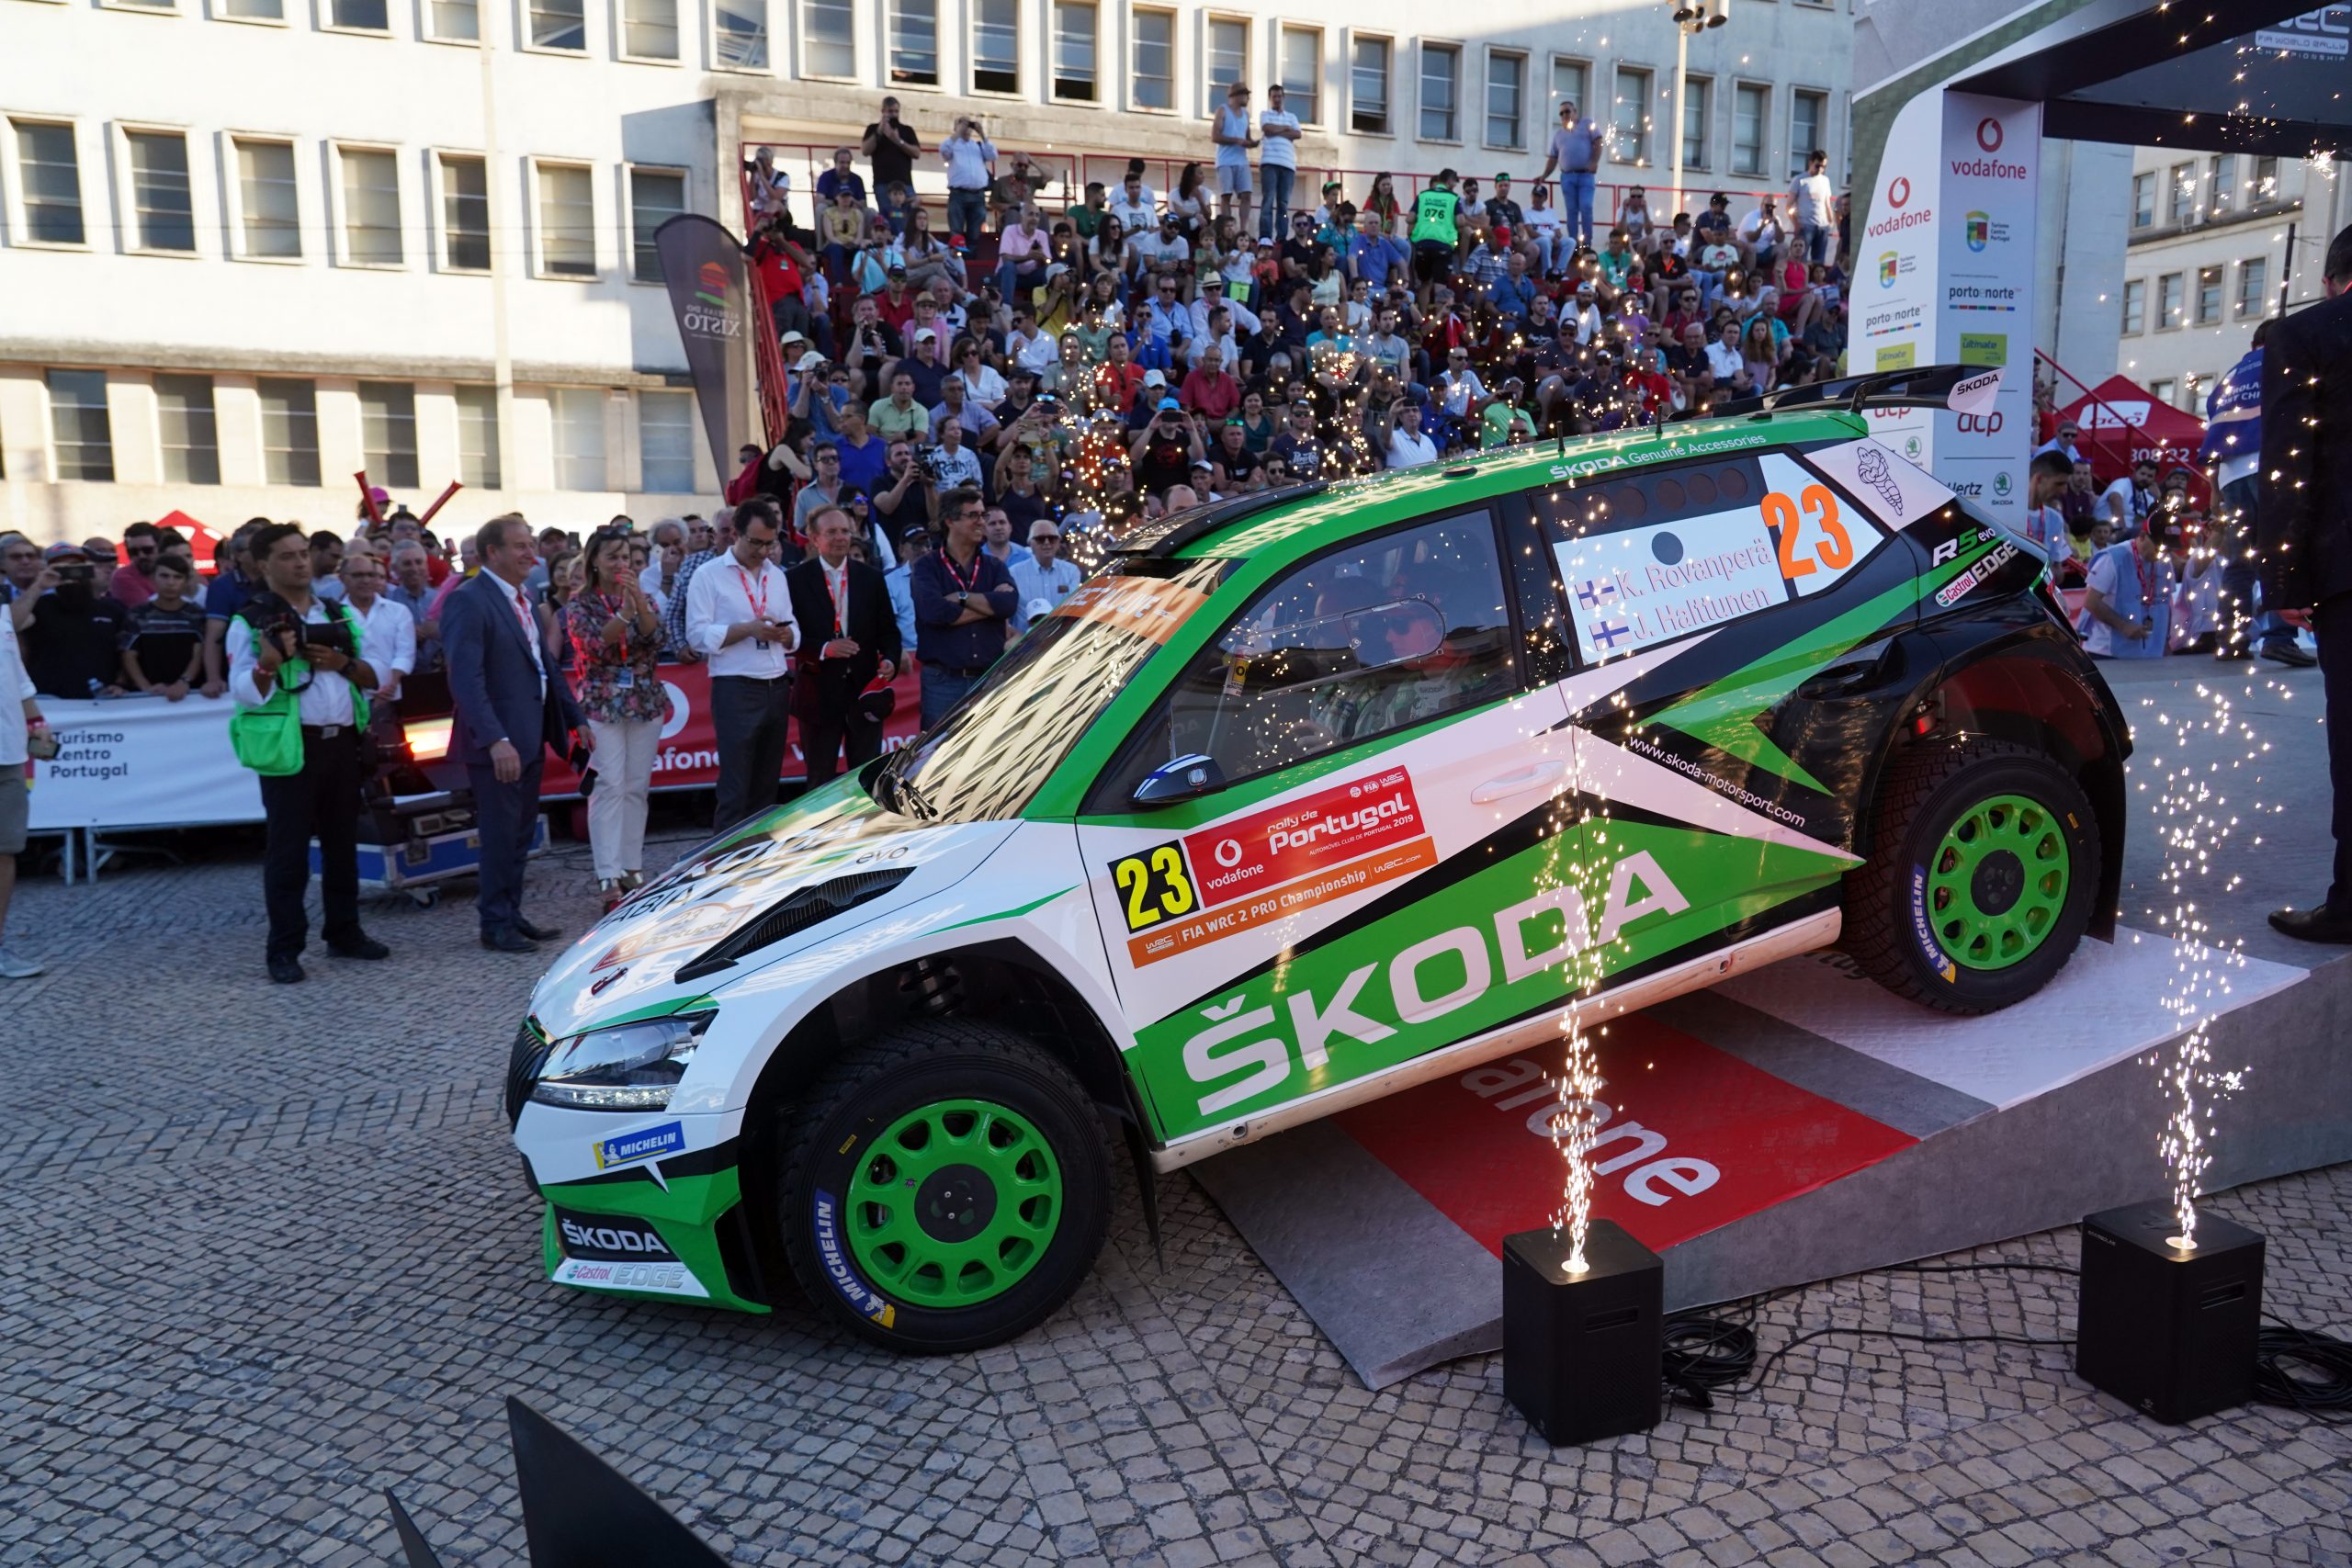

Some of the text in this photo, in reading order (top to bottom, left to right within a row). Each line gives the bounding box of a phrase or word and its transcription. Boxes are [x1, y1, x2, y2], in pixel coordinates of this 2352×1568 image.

[2257, 49, 2346, 62] CHAPIONSHIP
[1951, 158, 2027, 179] vodafone
[1424, 208, 1445, 220] 076
[1868, 209, 1932, 238] vodafone
[1957, 373, 1999, 396] ŠKODA
[1957, 412, 2003, 437] acp
[1550, 434, 1767, 479] ŠKODA Genuine Accessories
[1760, 484, 1854, 581] 23
[1977, 527, 1996, 542] evo
[1616, 538, 1773, 600] K. Rovanperä
[1945, 539, 2019, 602] Castrol EDGE
[1634, 615, 1654, 641] J.
[53, 730, 125, 745] Turismo
[55, 750, 111, 761] entro
[51, 763, 129, 780] Portugal
[1629, 736, 1805, 828] www.skoda-motorsport.com
[1267, 810, 1318, 834] rally de
[1269, 792, 1410, 856] Portugal
[1341, 837, 1355, 846] CLUB
[1363, 824, 1393, 838] PORTUGAL
[1393, 814, 1414, 828] 2019
[855, 846, 909, 864] evo
[1116, 846, 1193, 930] 23
[1206, 863, 1264, 890] vodafone
[1181, 869, 1367, 942] FIA WRC 2 PRO Championship
[1913, 874, 1939, 960] MICHELIN
[1181, 850, 1691, 1116] ŠKODA
[619, 1132, 676, 1156] MICHELIN
[561, 1218, 670, 1254] ŠKODA
[818, 1201, 866, 1301] MICHELIN
[575, 1263, 688, 1289] Castrol EDGE
